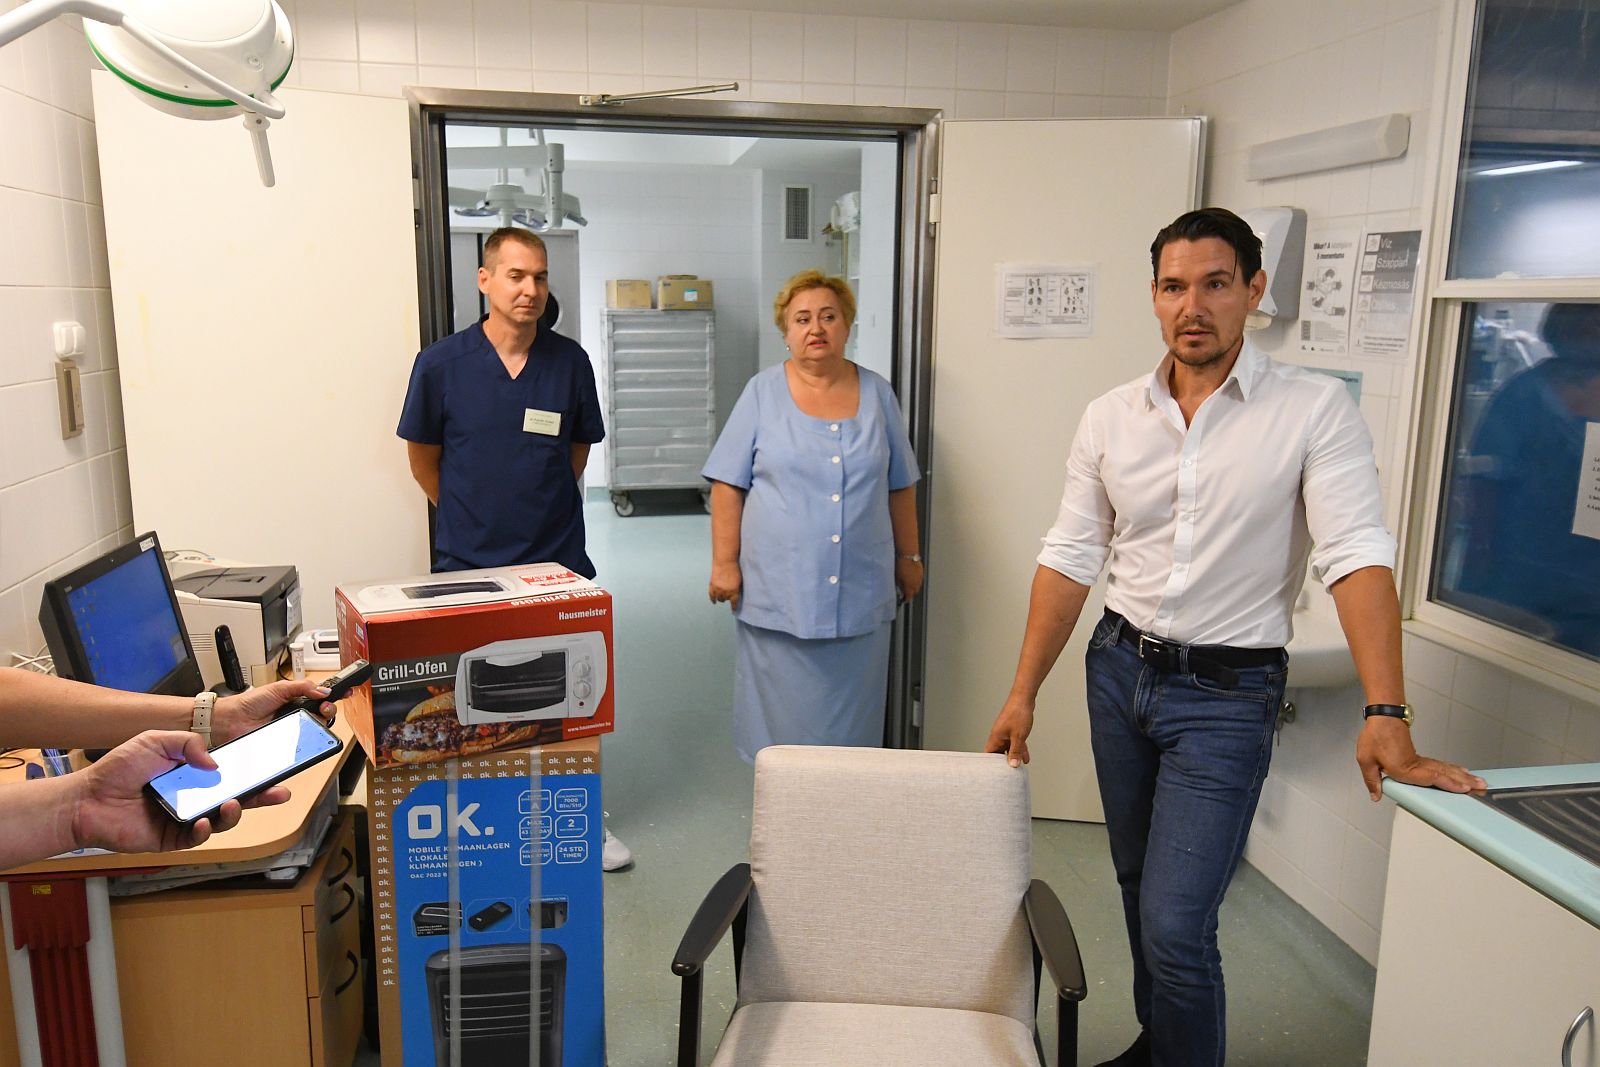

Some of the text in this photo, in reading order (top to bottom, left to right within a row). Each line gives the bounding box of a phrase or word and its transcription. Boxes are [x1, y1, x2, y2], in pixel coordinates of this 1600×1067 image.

[558, 608, 607, 620] Hausmeister
[378, 661, 447, 681] Grill-Ofen
[408, 794, 494, 840] ok.
[567, 819, 575, 828] 2
[408, 842, 510, 854] MOBILE KMAANLAGEN
[415, 854, 448, 862] LOKALE
[409, 860, 476, 870] KLIMAANGEN
